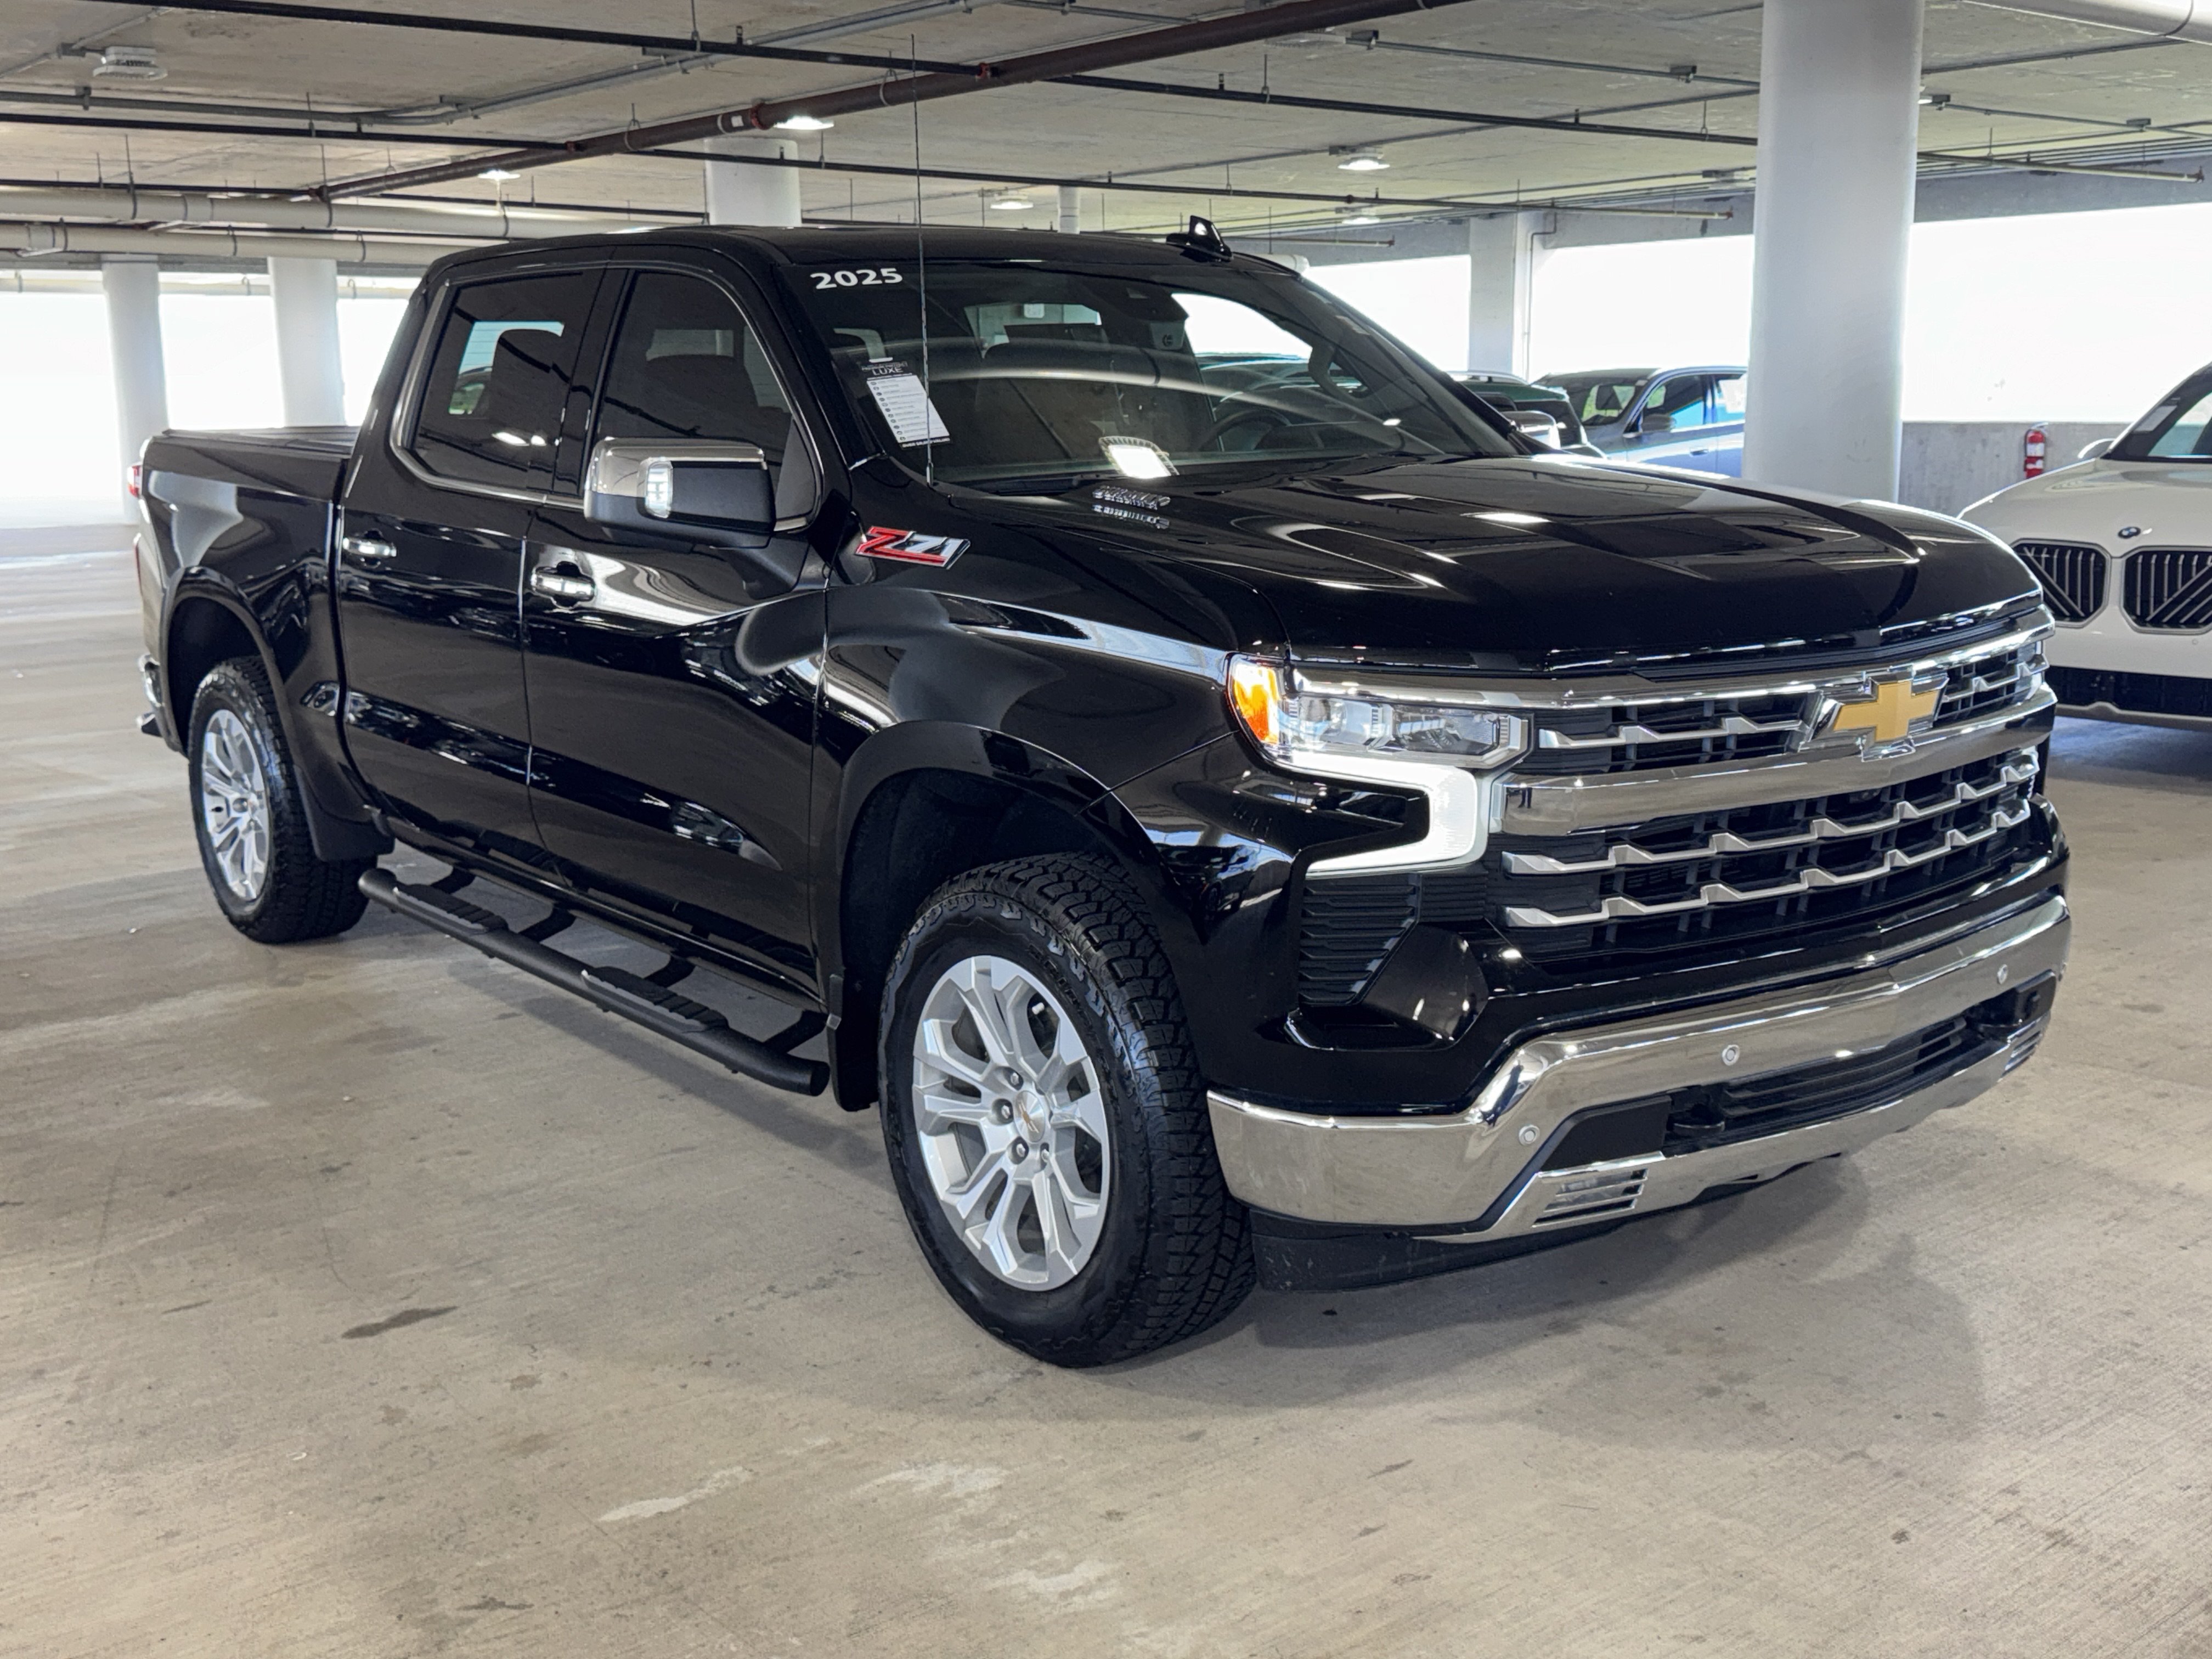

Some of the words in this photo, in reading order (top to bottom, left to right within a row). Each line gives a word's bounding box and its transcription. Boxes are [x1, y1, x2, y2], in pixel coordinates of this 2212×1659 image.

[810, 268, 903, 290] 2025
[872, 366, 904, 376] LUXE
[855, 526, 971, 570] Z71
